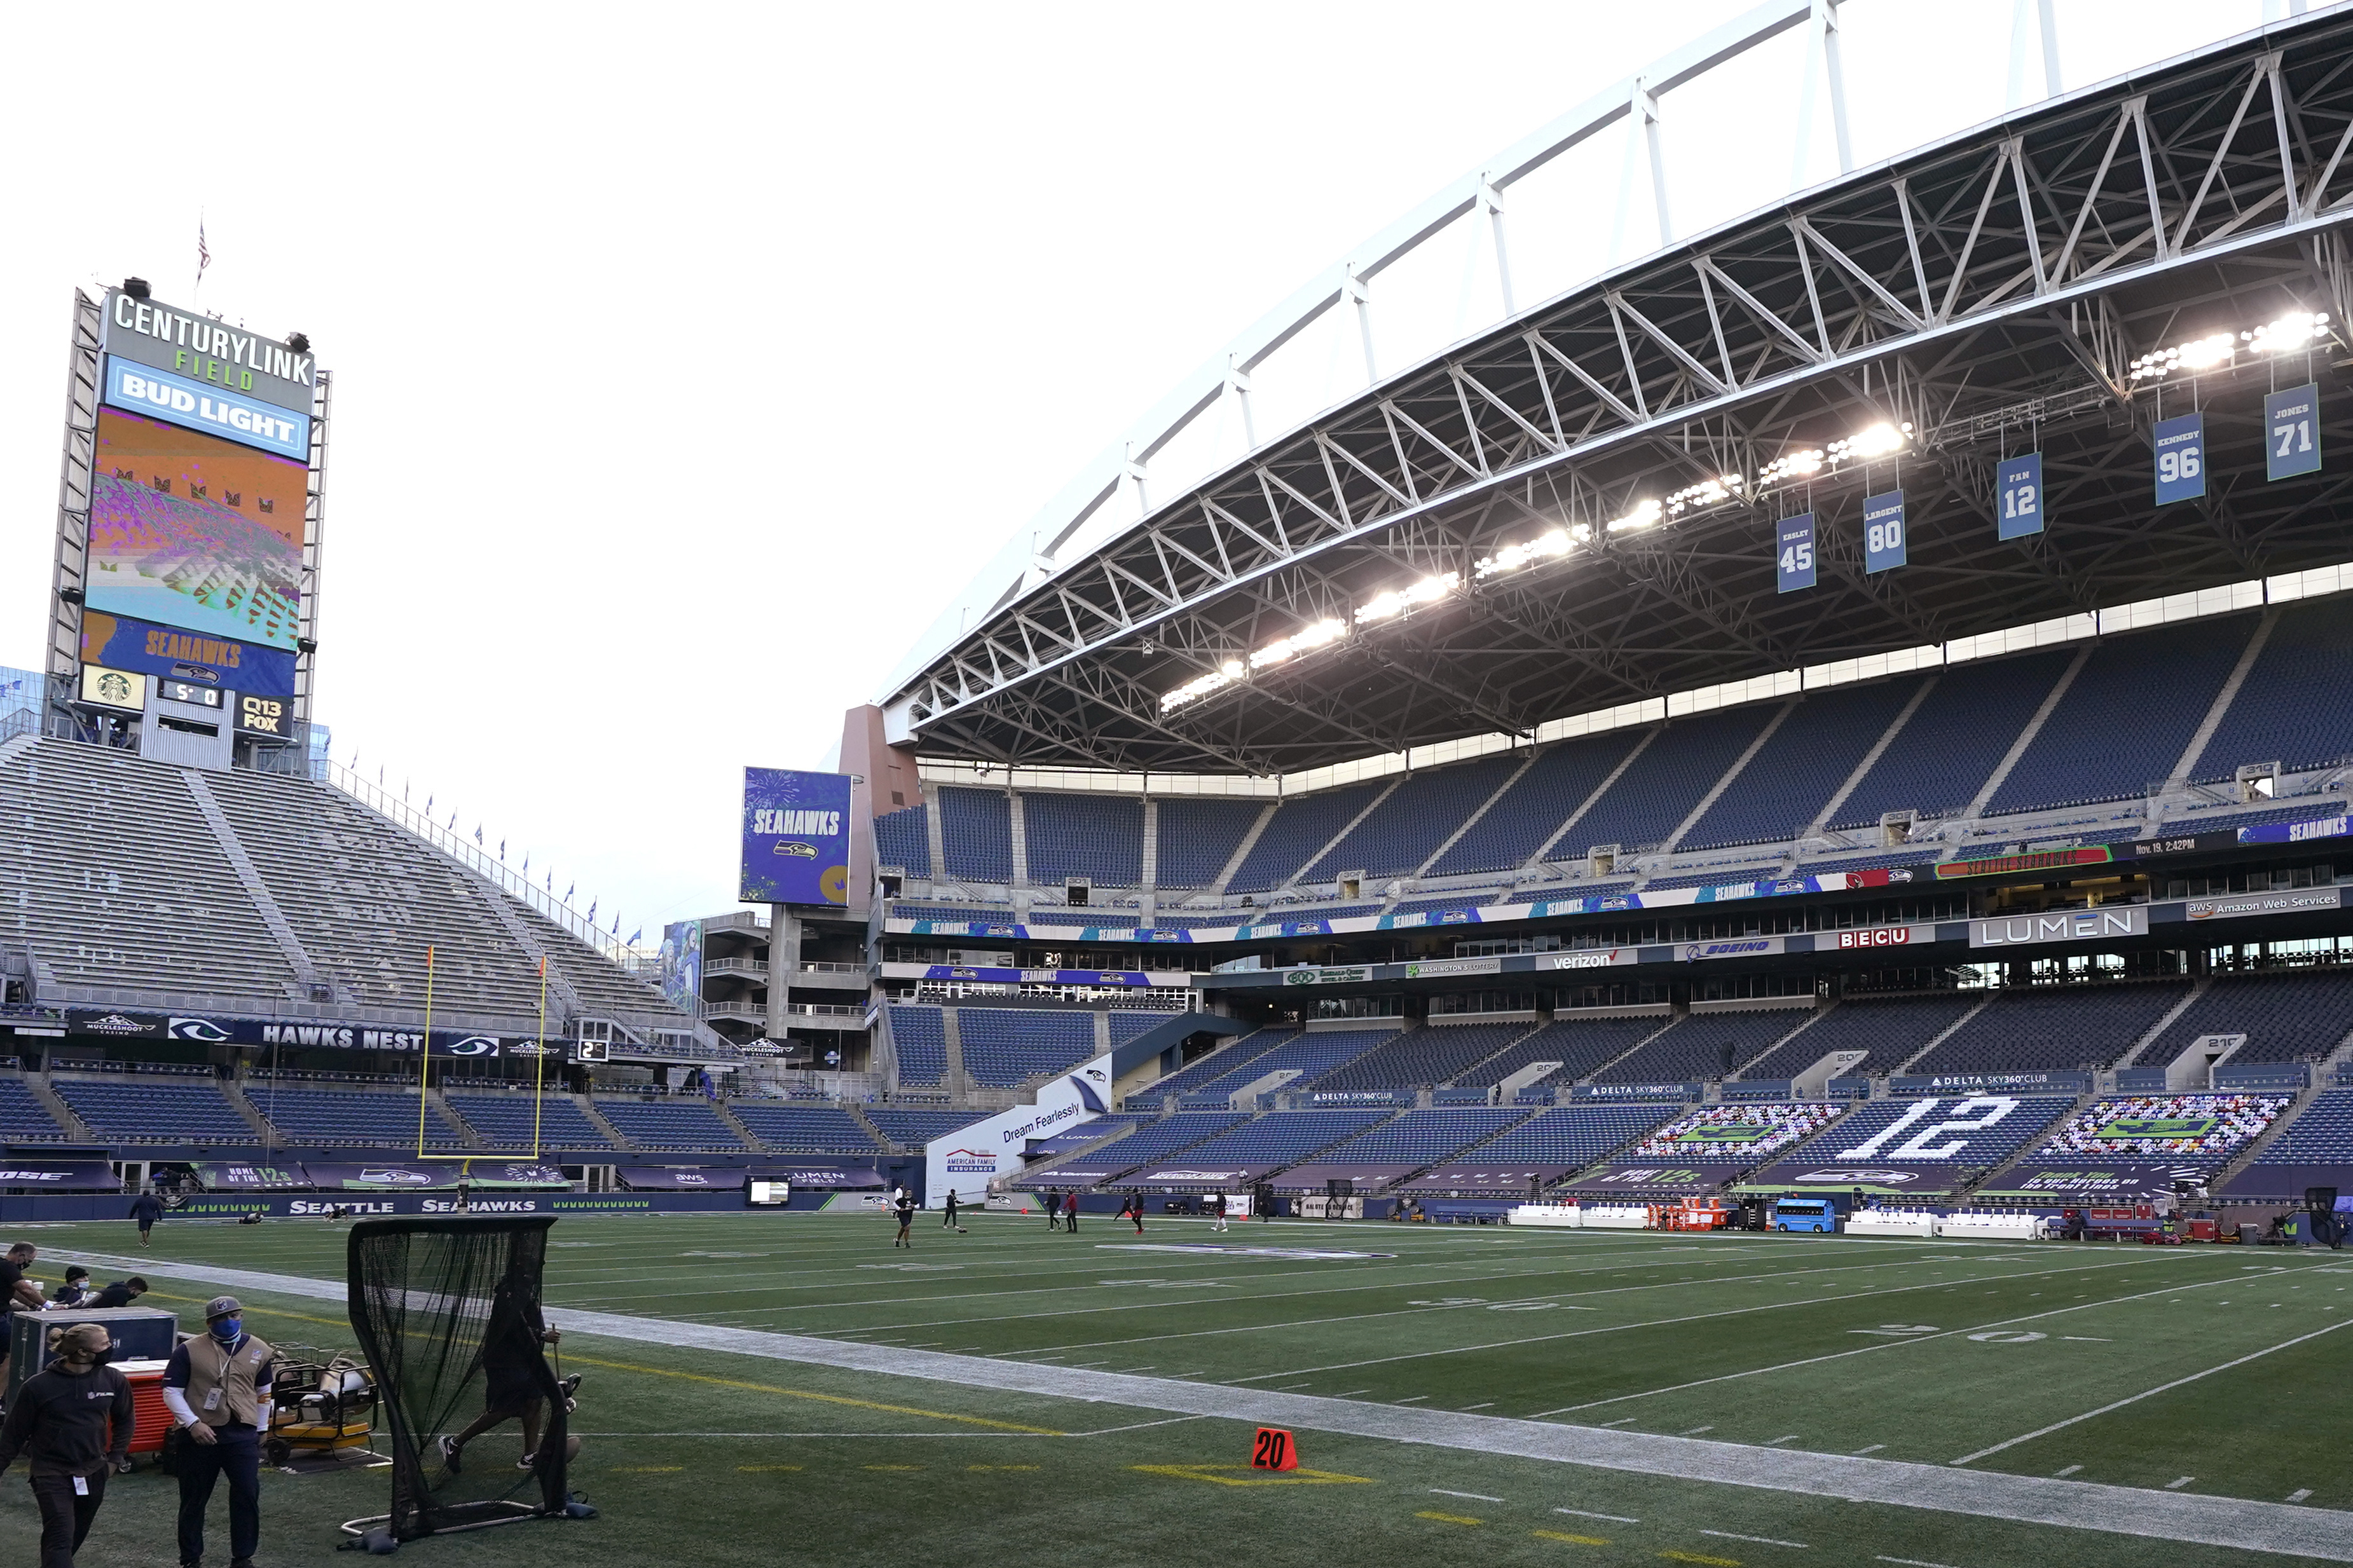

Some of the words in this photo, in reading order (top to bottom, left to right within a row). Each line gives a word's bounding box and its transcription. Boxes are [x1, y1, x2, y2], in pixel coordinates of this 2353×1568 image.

[114, 294, 310, 386] CENTURYLINK
[175, 350, 252, 391] FIELD
[122, 373, 195, 412] BUD
[200, 397, 295, 442] LIGHT
[2275, 404, 2309, 419] JONES
[2158, 430, 2199, 446] KENNEDY
[2274, 420, 2312, 457] 71
[2160, 447, 2200, 484] 96
[2009, 471, 2029, 483] FAN
[2005, 485, 2035, 519] 12
[1865, 505, 1902, 521] LARGENT
[1783, 529, 1809, 542] EASLEY
[1869, 520, 1901, 553] 80
[1780, 542, 1812, 573] 45
[146, 631, 241, 668] SEAHAWKS
[243, 697, 282, 716] Q13
[244, 713, 278, 732] FOX
[2246, 764, 2273, 775] 310
[754, 809, 840, 836] SEAHAWKS
[2289, 817, 2347, 842] SEAHAWKS
[2136, 844, 2152, 855] Nov.
[2166, 838, 2195, 852] 2:42PM
[1968, 857, 2010, 875] SEATTLE
[2017, 850, 2076, 869] SEAHAWKS
[1715, 882, 1755, 901] SEAHAWKS
[1547, 899, 1582, 916] SEAHAWKS
[2189, 903, 2212, 913] aws
[2217, 903, 2259, 913] Amazon
[2263, 899, 2288, 910] Web
[2292, 894, 2336, 907] Services
[931, 922, 969, 934] SEAHAWKS
[1393, 912, 1427, 929] SEAHAWKS
[1982, 910, 2132, 945] LUMEN
[1099, 929, 1135, 941] SEAHAWKS
[1251, 924, 1282, 938] SEAHAWKS
[1841, 929, 1906, 948] BECU
[1706, 941, 1769, 955] BOEING
[1419, 964, 1469, 974] WASHINGTON'S
[1470, 962, 1499, 971] LOTTERY
[1553, 951, 1610, 970] verizon
[1020, 971, 1057, 982] SEAHAWKS
[86, 1024, 143, 1032] MUCKLESHOOT
[263, 1025, 353, 1048] HAWKS
[363, 1031, 423, 1050] NEST
[1945, 1077, 1982, 1085] DELTA
[1003, 1122, 1034, 1143] Dream
[1036, 1102, 1080, 1130] Fearlessly
[1836, 1096, 2020, 1159] 12
[256, 1168, 292, 1182] 12s
[675, 1173, 704, 1182] aws
[1650, 1169, 1701, 1182] 12s
[290, 1200, 394, 1214] SEATTLE
[422, 1199, 535, 1213] SEAHAWKS
[1254, 1431, 1285, 1468] 20
